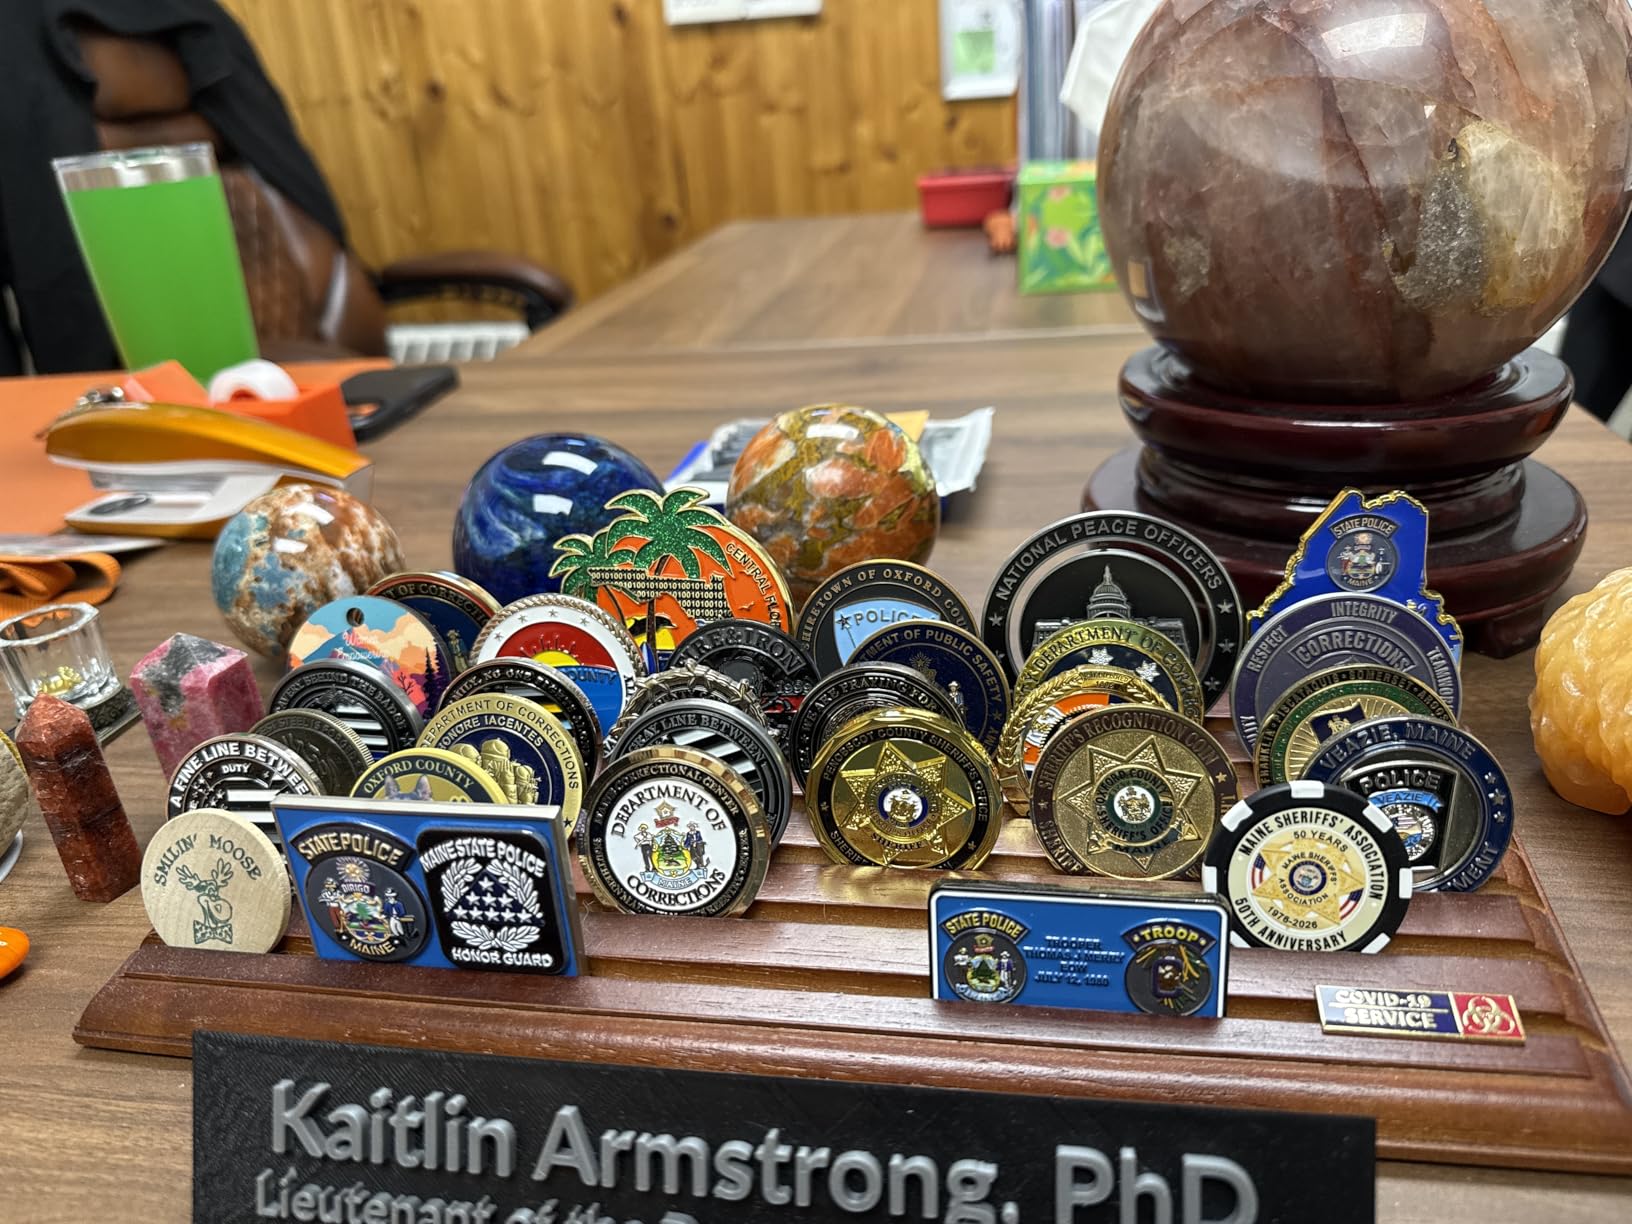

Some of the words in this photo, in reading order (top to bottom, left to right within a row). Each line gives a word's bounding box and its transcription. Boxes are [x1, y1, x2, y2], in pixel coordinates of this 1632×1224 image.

[1334, 518, 1360, 539] STATE
[1361, 517, 1395, 534] POLICE
[726, 543, 772, 595] CENTRAL
[996, 531, 1068, 600] NATIONAL
[1071, 519, 1139, 539] PEACE
[1144, 524, 1223, 592] OFFICERS
[399, 583, 416, 595] OF
[801, 577, 853, 650] SHIRETOWN
[857, 569, 877, 582] OF
[883, 568, 943, 598] OXFORD
[944, 599, 969, 633] COU
[854, 609, 922, 626] POLIC
[1330, 602, 1398, 624] INTEGRITY
[903, 629, 921, 641] OF
[925, 629, 973, 656] PUBLIC
[972, 653, 1002, 702] SAFETY
[1034, 626, 1138, 672] DEPARTMENT
[1141, 636, 1164, 653] OF
[1246, 623, 1289, 673] RESPECT
[1294, 631, 1411, 673] CORRECTIONS
[449, 675, 482, 705] MILY,
[1348, 669, 1414, 691] SOMERSET
[303, 671, 349, 684] BEHIND
[351, 675, 377, 697] THE
[375, 690, 407, 730] BADGE
[801, 710, 818, 732] WE
[815, 687, 841, 709] ARE
[838, 676, 908, 693] PRAYING
[908, 686, 938, 713] FOR
[484, 715, 545, 748] IACENTES
[496, 700, 515, 713] OF
[517, 706, 580, 790] CORRECTIONS
[628, 722, 660, 752] GRAY
[661, 714, 698, 731] LINE
[700, 714, 766, 763] BETWEEN
[1319, 724, 1400, 770] VEAZIE,
[1405, 722, 1477, 760] MAINE
[202, 742, 241, 762] LINE
[221, 763, 253, 774] DUTY
[1038, 728, 1087, 790] SHERIFF'S
[1090, 712, 1187, 740] RECOGNITION
[173, 755, 203, 792] FINE
[363, 759, 413, 794] OXFORD
[414, 758, 475, 790] COUNTY
[616, 764, 703, 791] CORRECTIONAL
[702, 776, 740, 816] CENTER
[823, 730, 879, 782] PENOBSCOT
[877, 727, 927, 740] COUNTY
[928, 731, 979, 783] SHERIFF'S
[974, 779, 989, 822] OFFICE
[1095, 770, 1127, 804] OXFORD
[1129, 768, 1169, 794] COUNTY
[1359, 768, 1441, 795] POLICE
[170, 795, 182, 808] A
[611, 784, 710, 838] DEPARTMENT
[705, 807, 728, 832] OF
[1097, 808, 1147, 841] SHERIFF'S
[1293, 830, 1306, 839] 50
[1311, 830, 1350, 853] YEARS
[154, 833, 198, 887] SMILIN'
[208, 833, 262, 881] MOOSE
[297, 832, 342, 861] STATE
[340, 832, 404, 866] POLICE
[418, 840, 458, 873] MAINE
[455, 837, 497, 858] STATE
[496, 840, 547, 878] POLICE
[1238, 821, 1273, 856] MAINE
[1274, 811, 1345, 828] SHERIFFS'
[1343, 826, 1385, 901] ASSOCIATION
[341, 882, 371, 894] DIRIGO
[627, 868, 726, 907] CORRECTIONS
[1279, 878, 1329, 905] ASSOCIATION
[945, 912, 981, 934] STATE
[982, 913, 1024, 938] POLICE
[1140, 924, 1199, 942] TROOP
[1235, 897, 1261, 929] 50TH
[1258, 925, 1347, 952] ANNIVERSARY
[1267, 906, 1318, 929] 1976-2026
[349, 937, 396, 955] MAINE
[451, 946, 502, 964] HONOR
[502, 951, 553, 968] GUARD
[1023, 945, 1072, 960] THOMAS
[1045, 935, 1102, 950] TROOPER
[1335, 989, 1432, 1009] COVID-19
[1344, 1008, 1438, 1029] SERVICE
[270, 1078, 518, 1178] Kaitlin
[1055, 1144, 1259, 1224] PhD
[256, 1166, 498, 1224] Lieutenant
